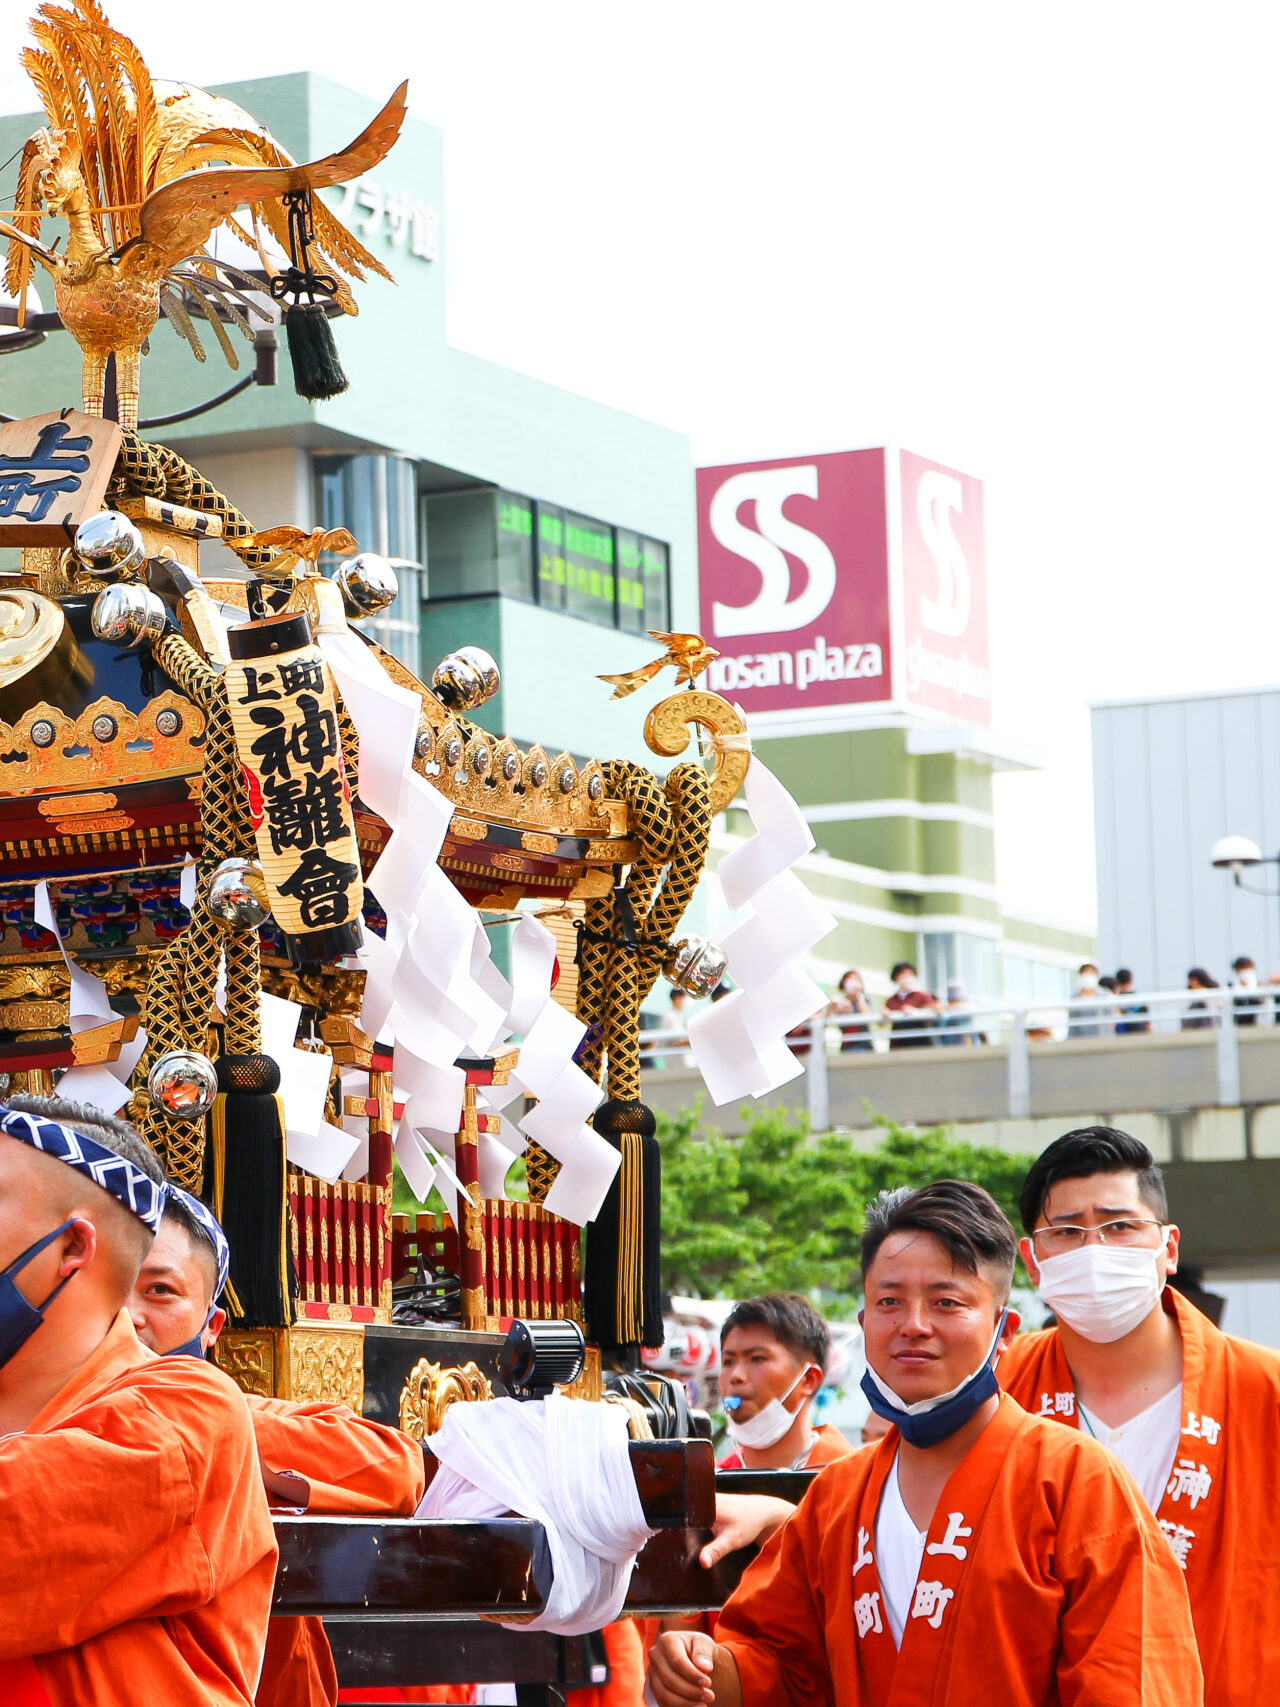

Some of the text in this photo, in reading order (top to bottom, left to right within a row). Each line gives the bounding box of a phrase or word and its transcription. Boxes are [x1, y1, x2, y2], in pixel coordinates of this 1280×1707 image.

[237, 658, 324, 705] 上町
[796, 636, 882, 690] plaza
[1036, 1392, 1076, 1417] 上町
[1181, 1411, 1222, 1446] 上町
[852, 1526, 884, 1638] 上町
[911, 1511, 973, 1629] 上町
